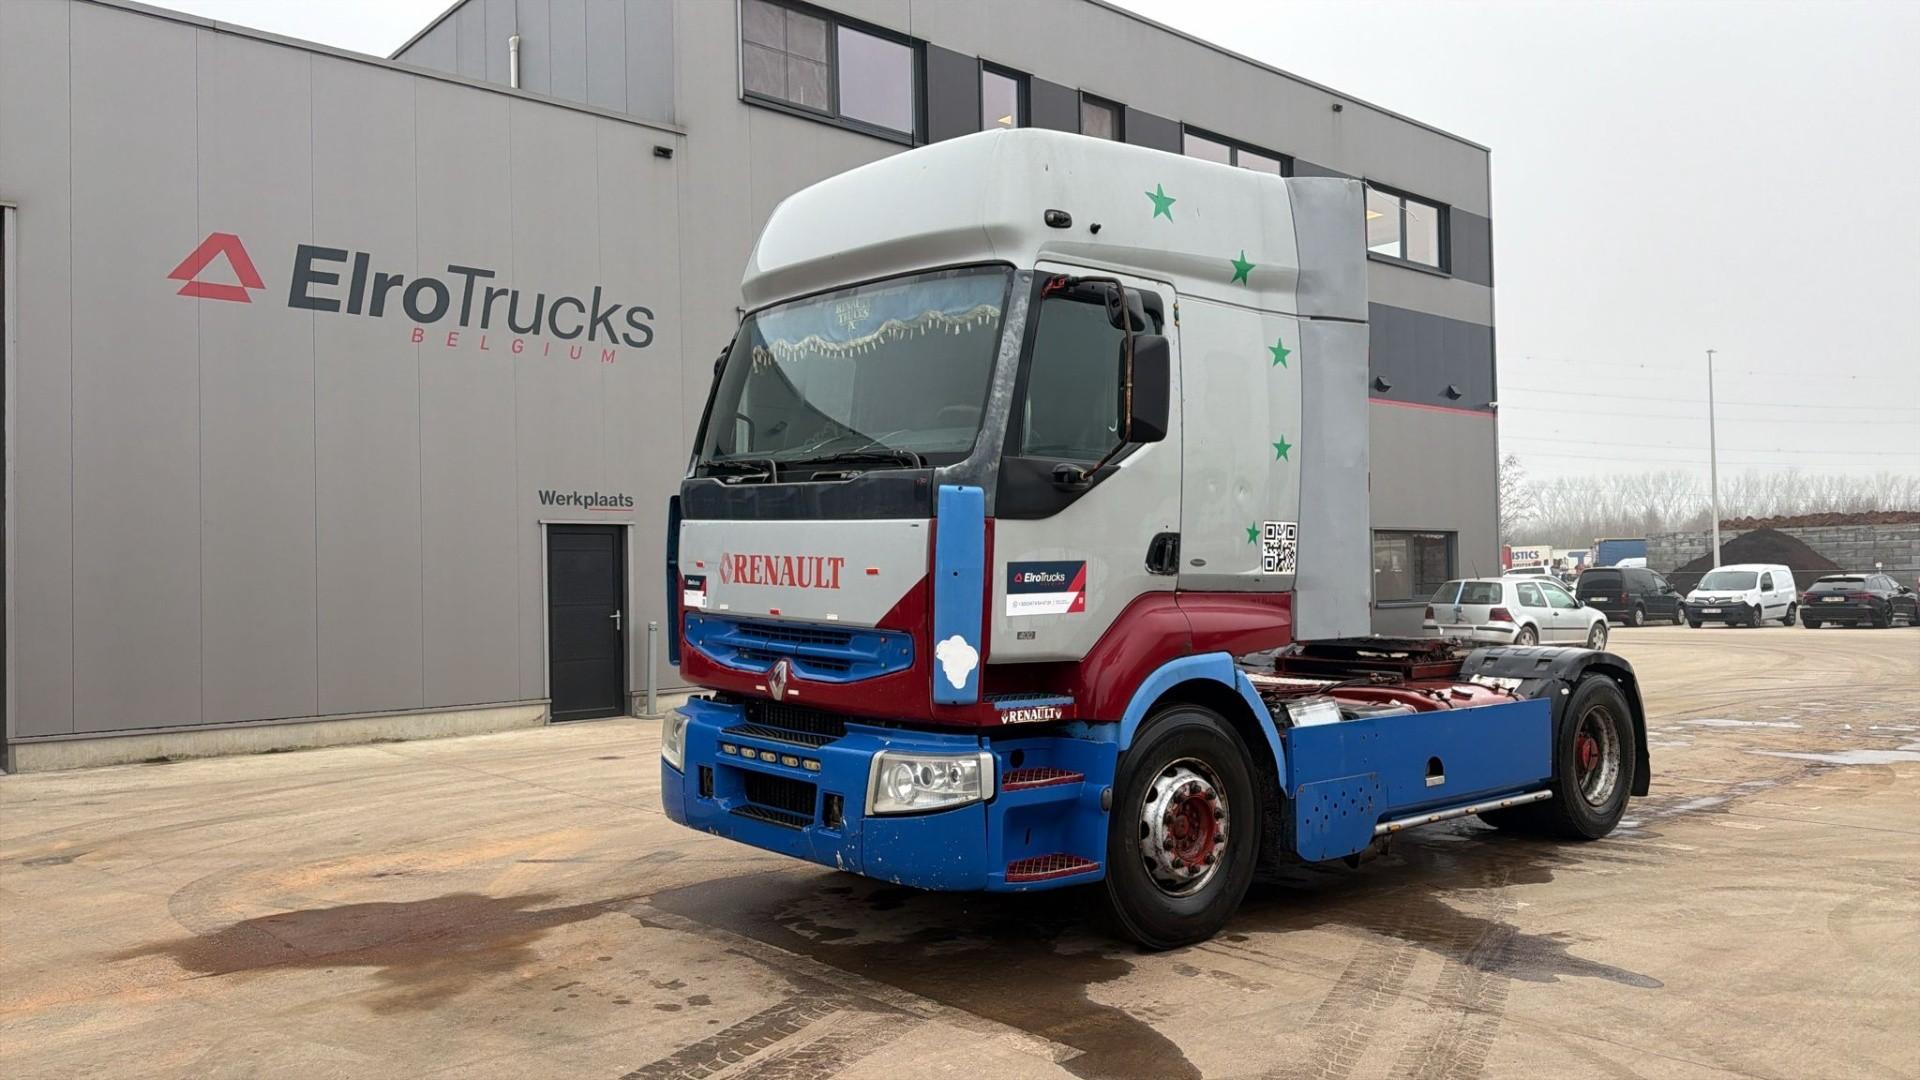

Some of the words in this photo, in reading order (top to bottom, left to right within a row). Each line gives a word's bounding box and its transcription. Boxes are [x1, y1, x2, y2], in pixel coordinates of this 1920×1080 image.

[288, 244, 655, 348] ElroTrucks
[411, 327, 616, 364] BELGIUM
[538, 489, 634, 509] Werkplaats
[733, 554, 845, 589] RENAULT
[1024, 572, 1066, 583] ElroTrucks
[1009, 707, 1056, 723] RENAULT
